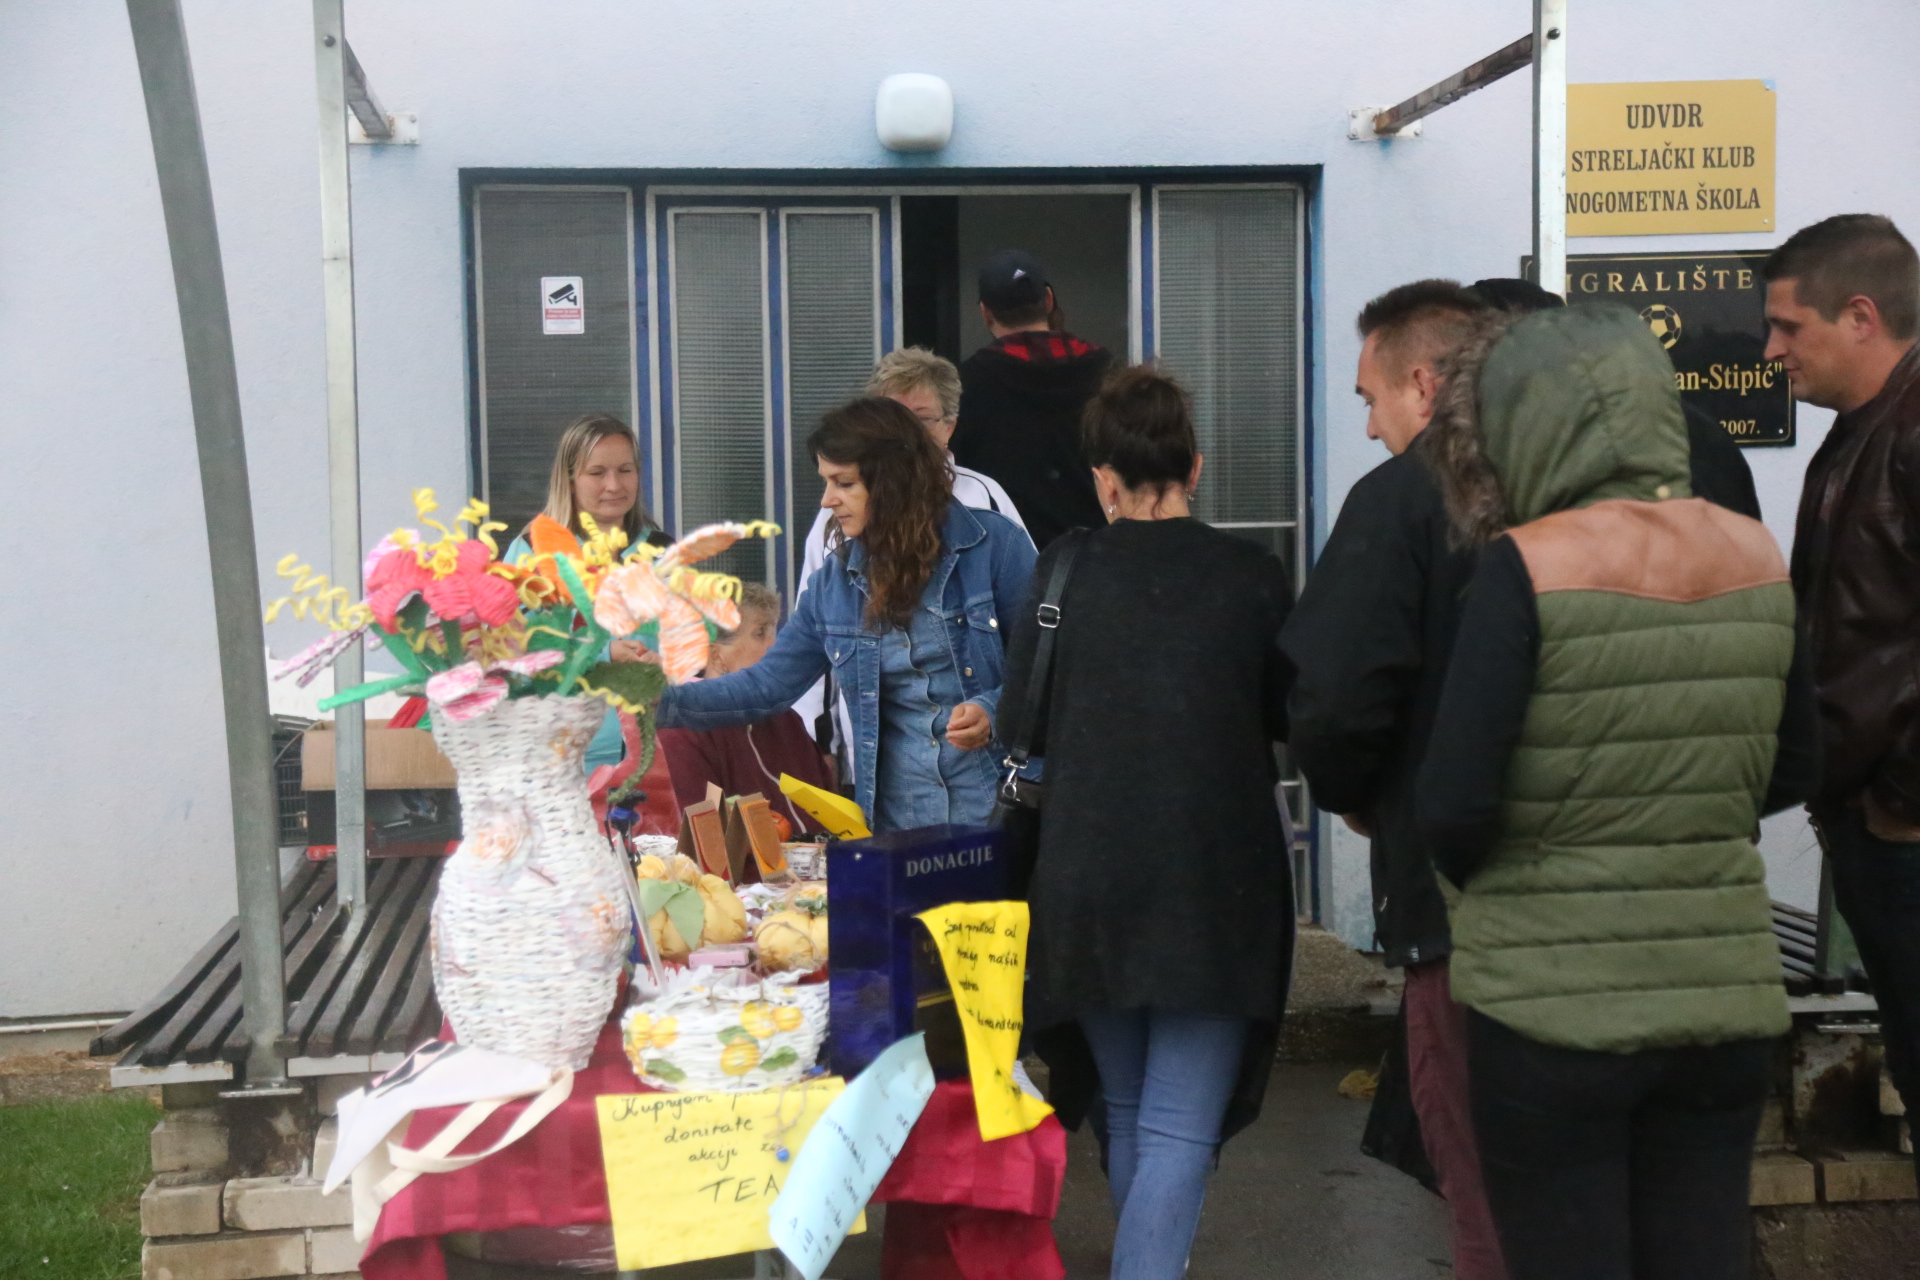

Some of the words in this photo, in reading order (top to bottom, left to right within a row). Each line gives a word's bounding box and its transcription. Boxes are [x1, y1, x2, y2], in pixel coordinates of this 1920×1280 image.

[1626, 103, 1704, 129] UDVDR
[1571, 141, 1695, 172] STRELJAČKI
[1702, 146, 1755, 169] KLUB
[1566, 190, 1690, 214] NOGOMETNA
[1696, 182, 1761, 210] ŠKOLA
[1566, 265, 1754, 294] IGRALIŠTE
[1675, 362, 1783, 396] an-Stipić"
[906, 846, 993, 877] DONACIJE
[664, 1116, 754, 1144] donirate
[688, 1146, 739, 1171] akciji
